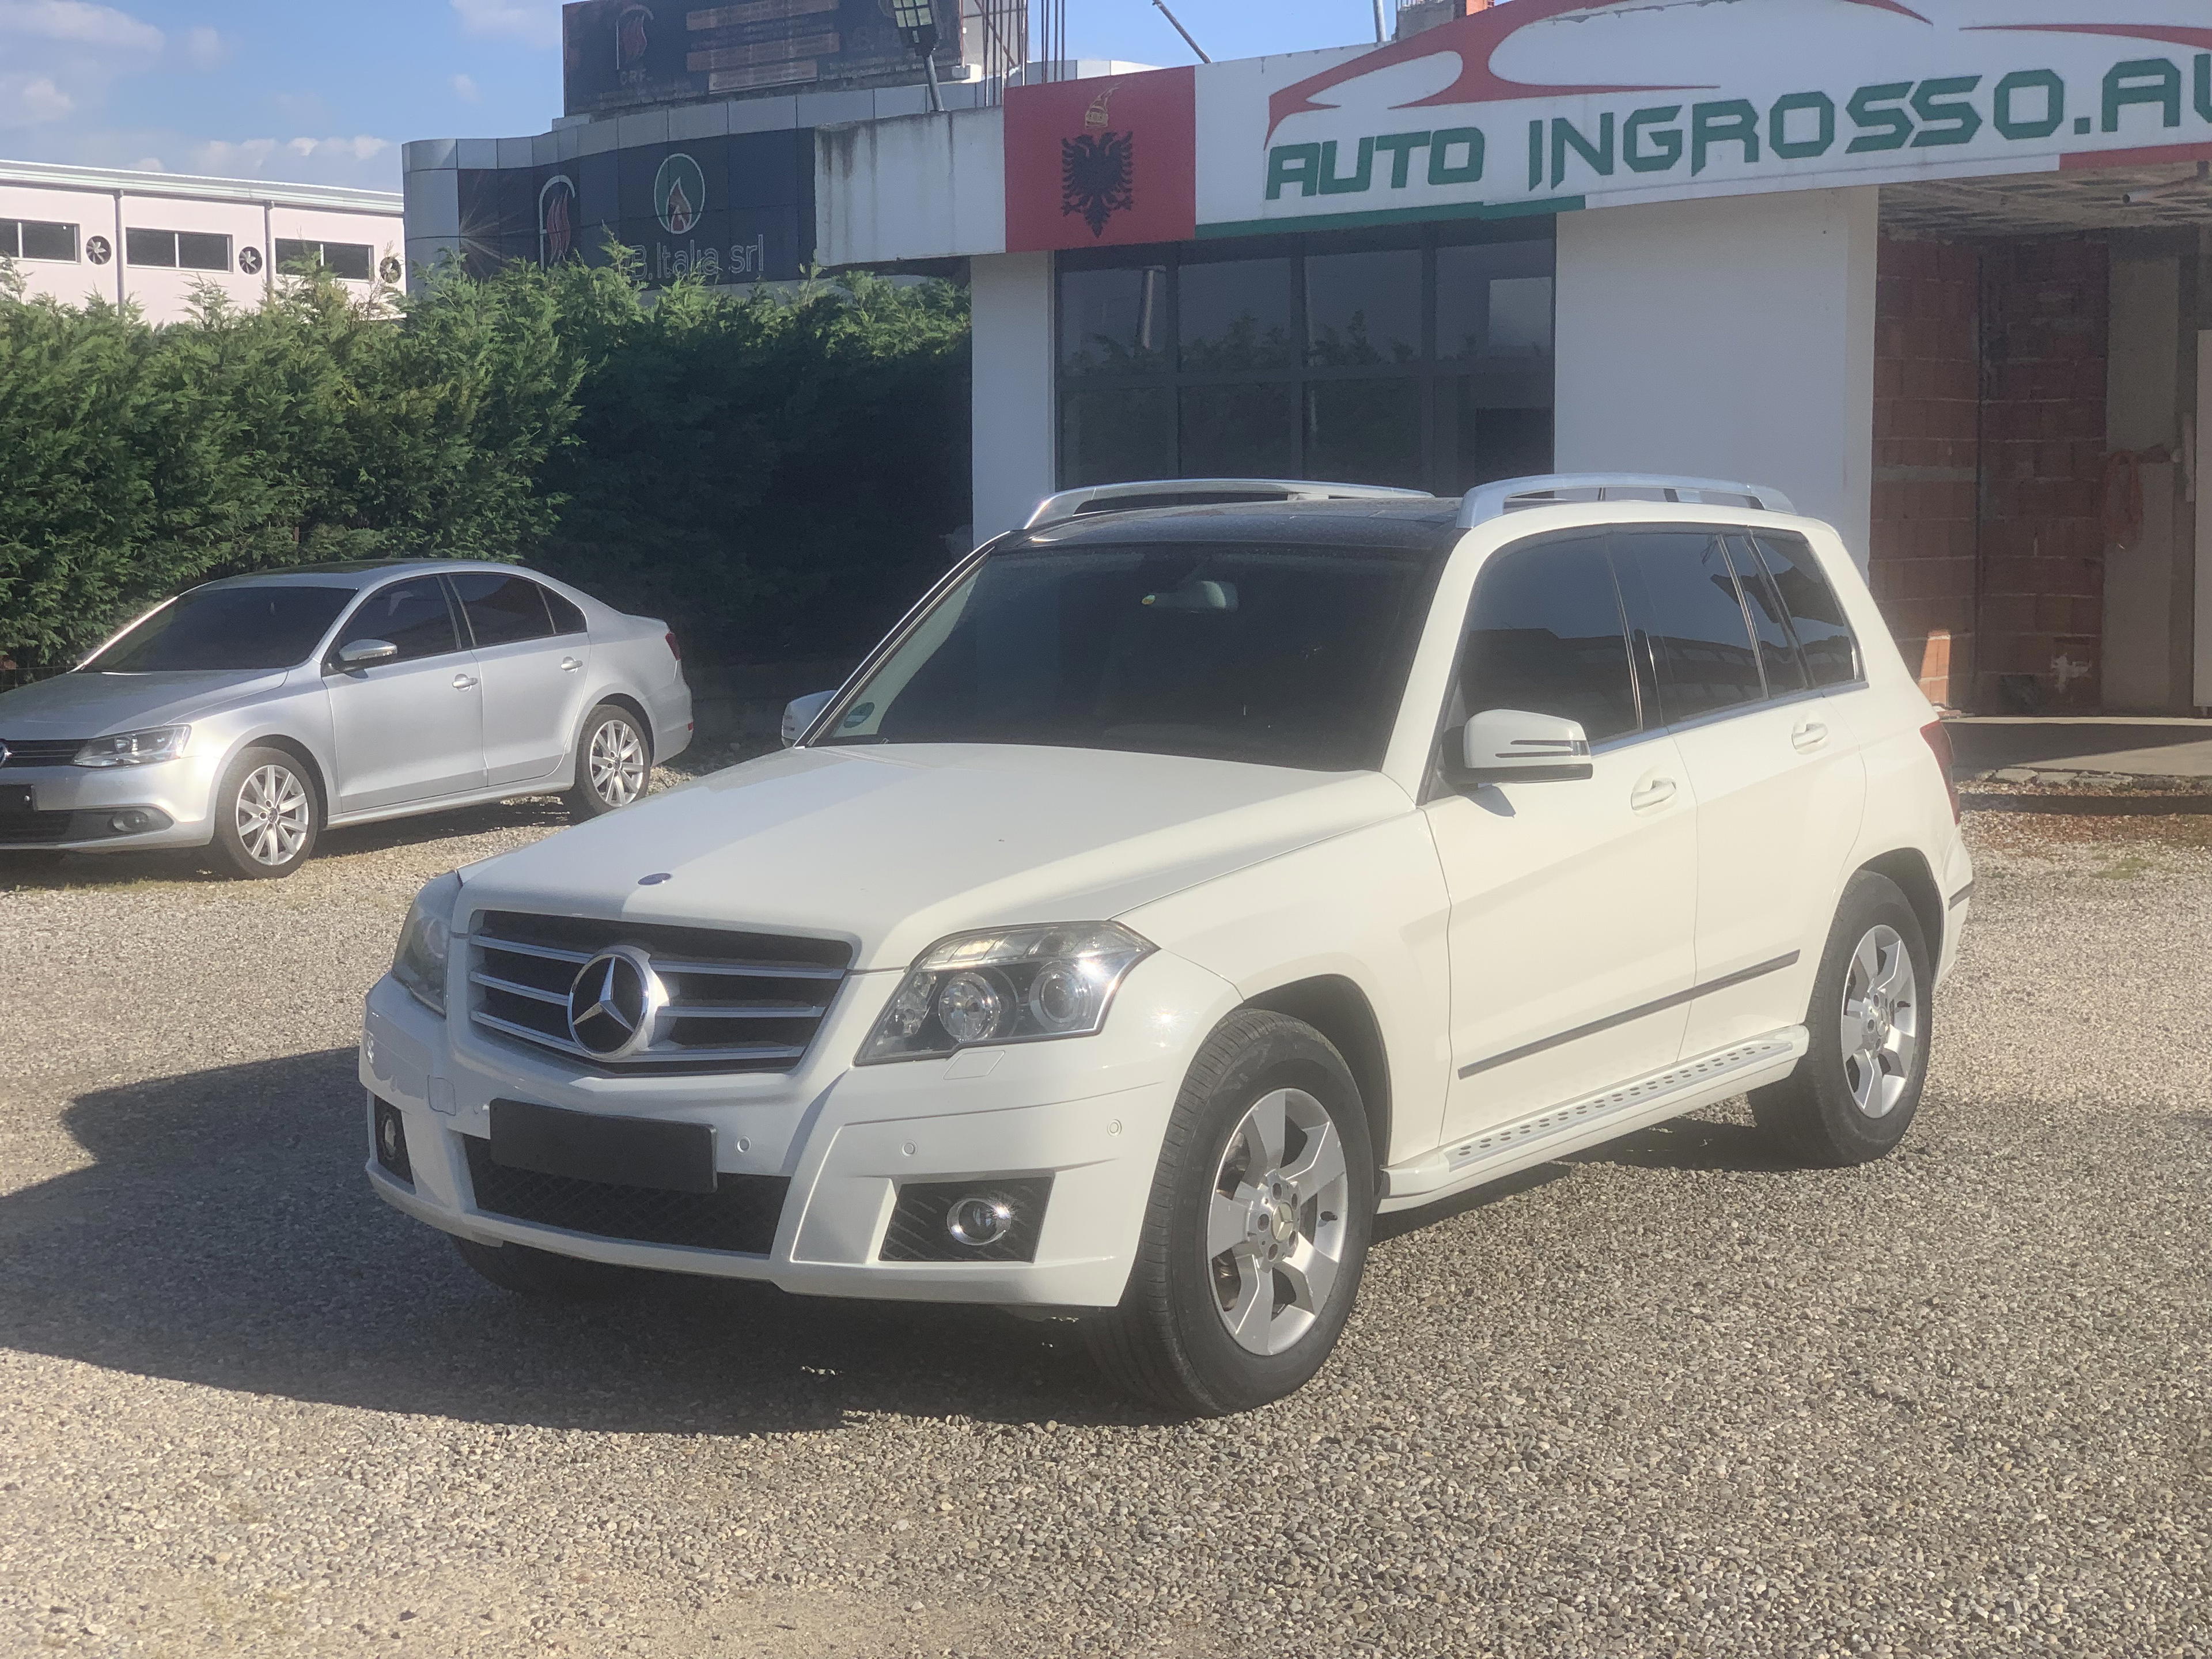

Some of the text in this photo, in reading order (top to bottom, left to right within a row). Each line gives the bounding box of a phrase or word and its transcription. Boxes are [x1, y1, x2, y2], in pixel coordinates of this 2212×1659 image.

[1266, 54, 2212, 200] AUTO INGROSSO.A
[730, 234, 764, 274] srl
